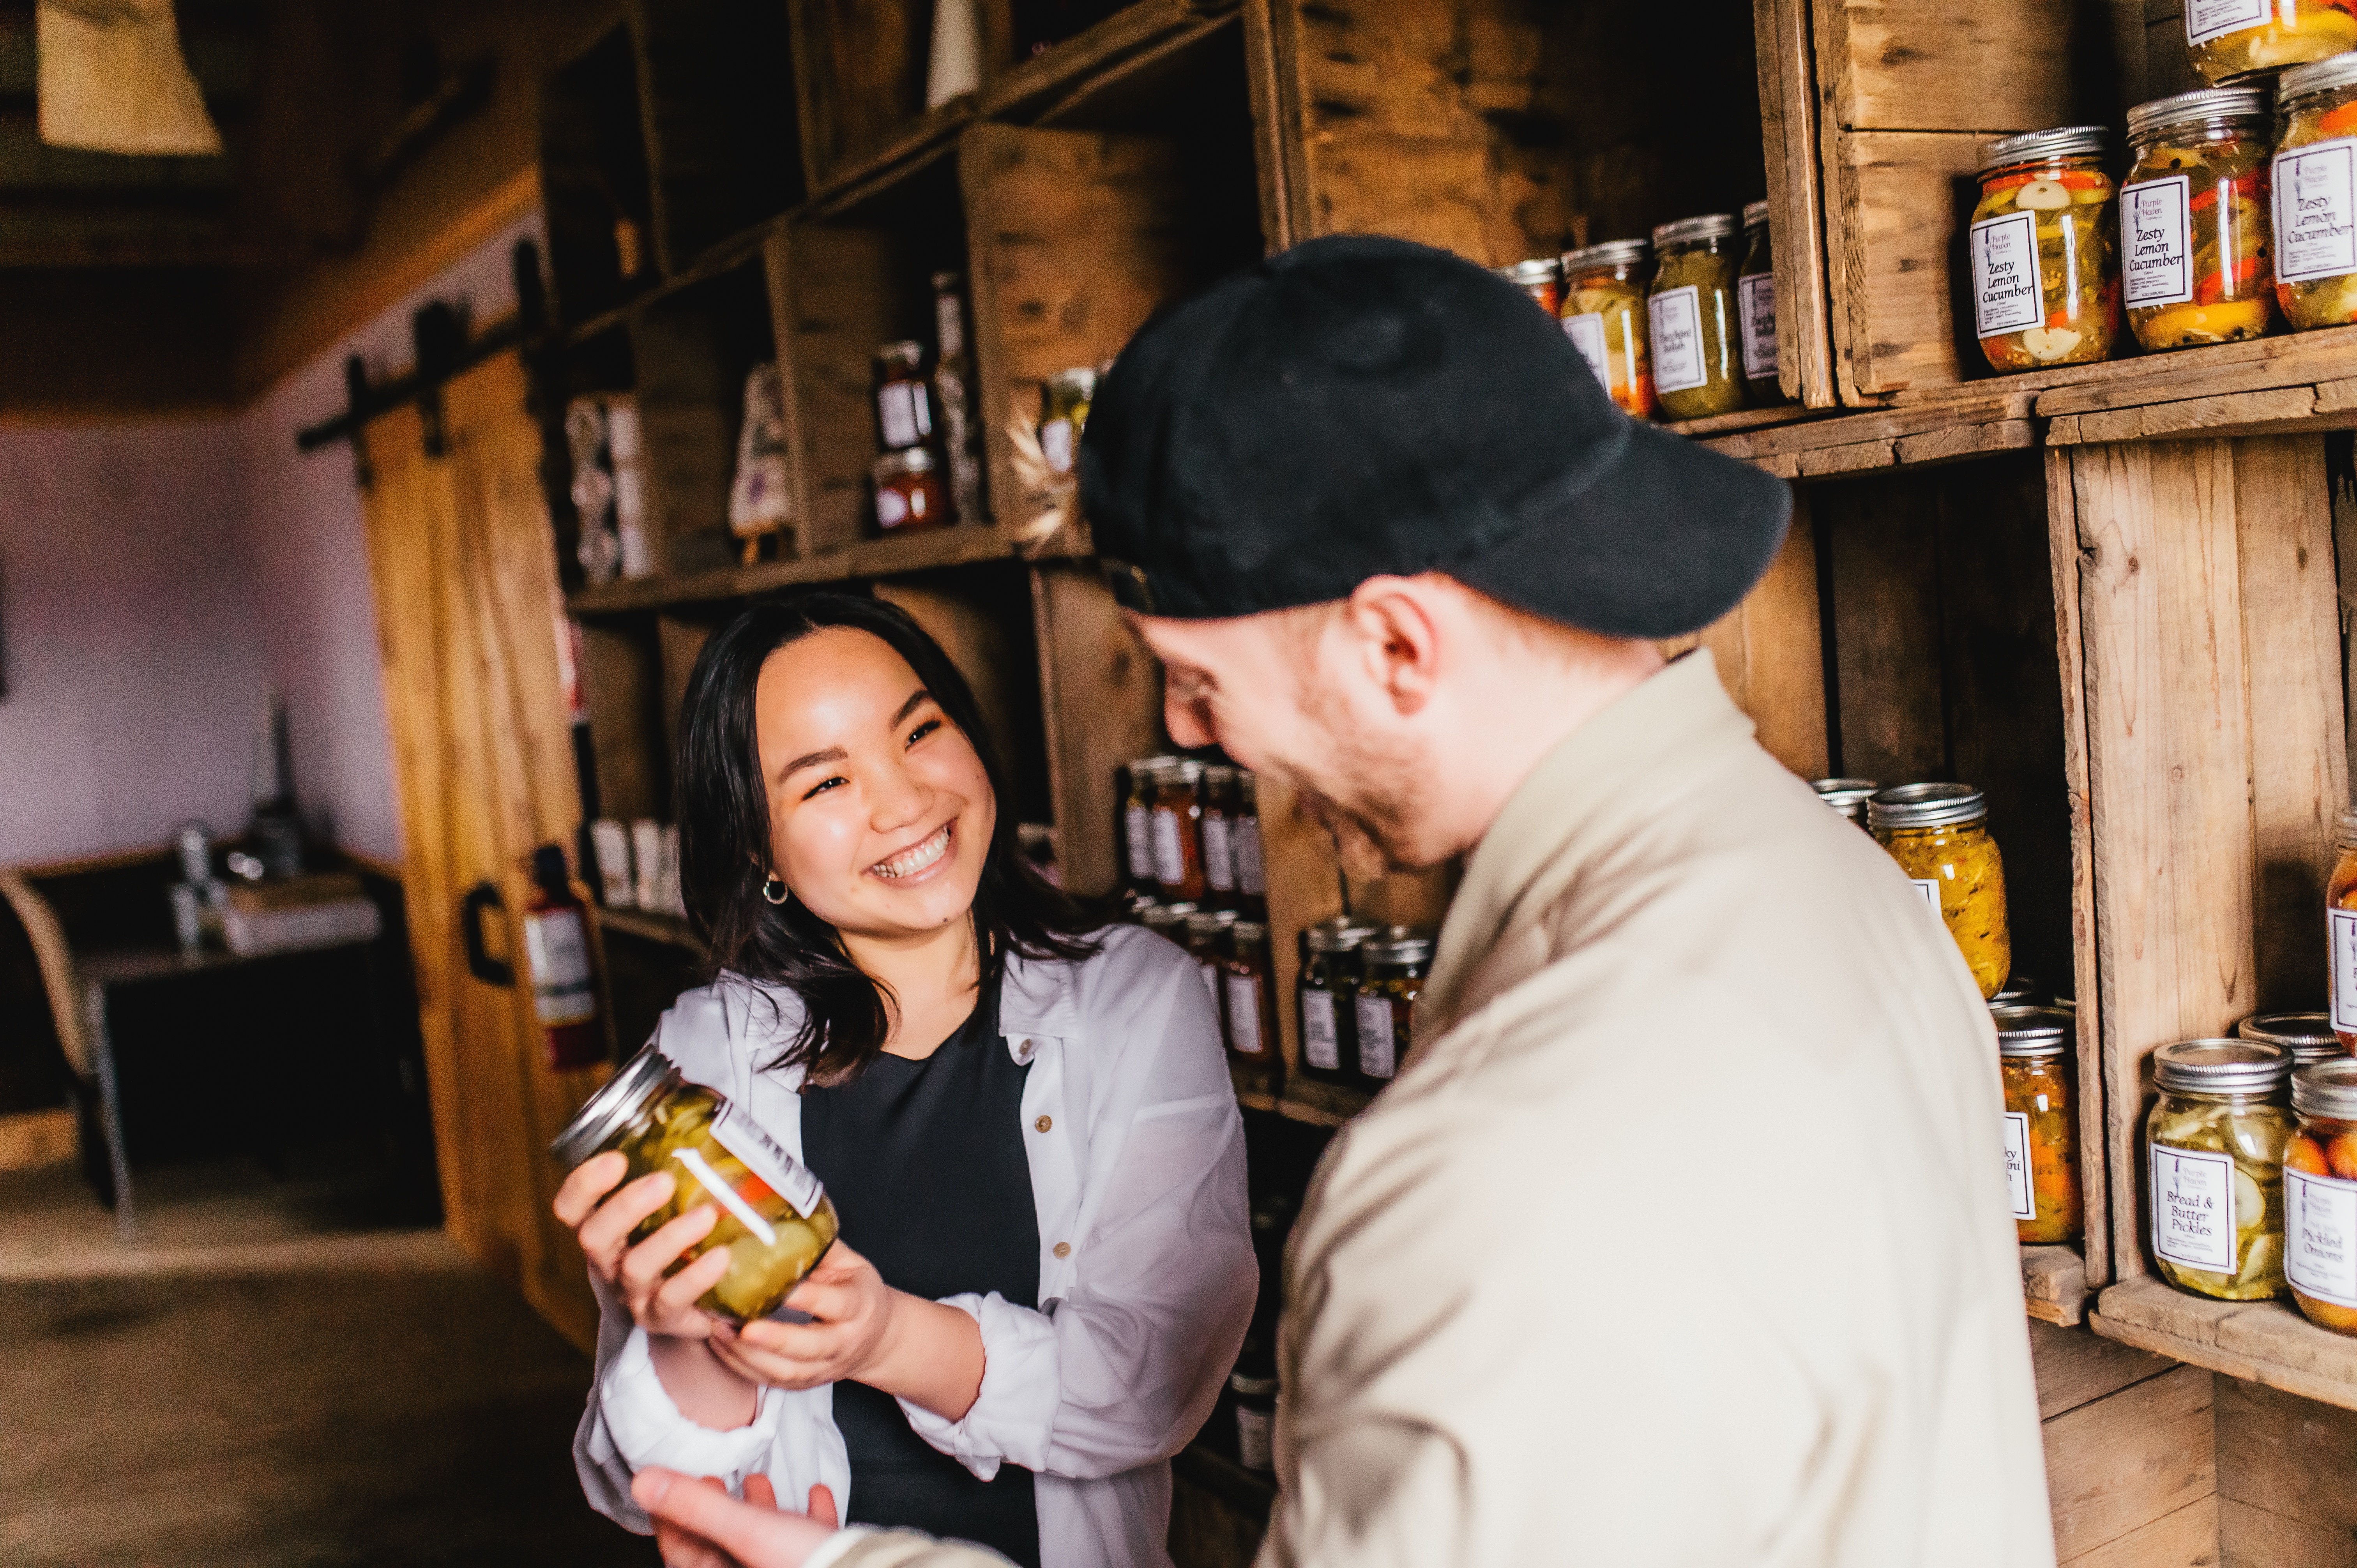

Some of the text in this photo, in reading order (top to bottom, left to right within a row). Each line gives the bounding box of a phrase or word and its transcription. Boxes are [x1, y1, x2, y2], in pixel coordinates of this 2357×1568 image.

[2141, 198, 2162, 208] Purple
[2297, 196, 2331, 212] Zesty
[2141, 208, 2162, 216] Haven
[2295, 212, 2336, 227] Lemon
[1991, 233, 2010, 243] Purple
[2137, 228, 2165, 242] Zesty
[2288, 222, 2353, 244] Cucumber
[1992, 242, 2011, 251] Haven
[2134, 242, 2169, 256] Lemon
[1989, 261, 2014, 275] Zesty
[2129, 253, 2183, 272] Cucumber
[1988, 274, 2020, 289] Lemon
[1983, 284, 2034, 303] Cucumber
[2167, 1191, 2215, 1210] Bread &
[2171, 1205, 2209, 1222] Butter
[2172, 1219, 2212, 1236] Pickles
